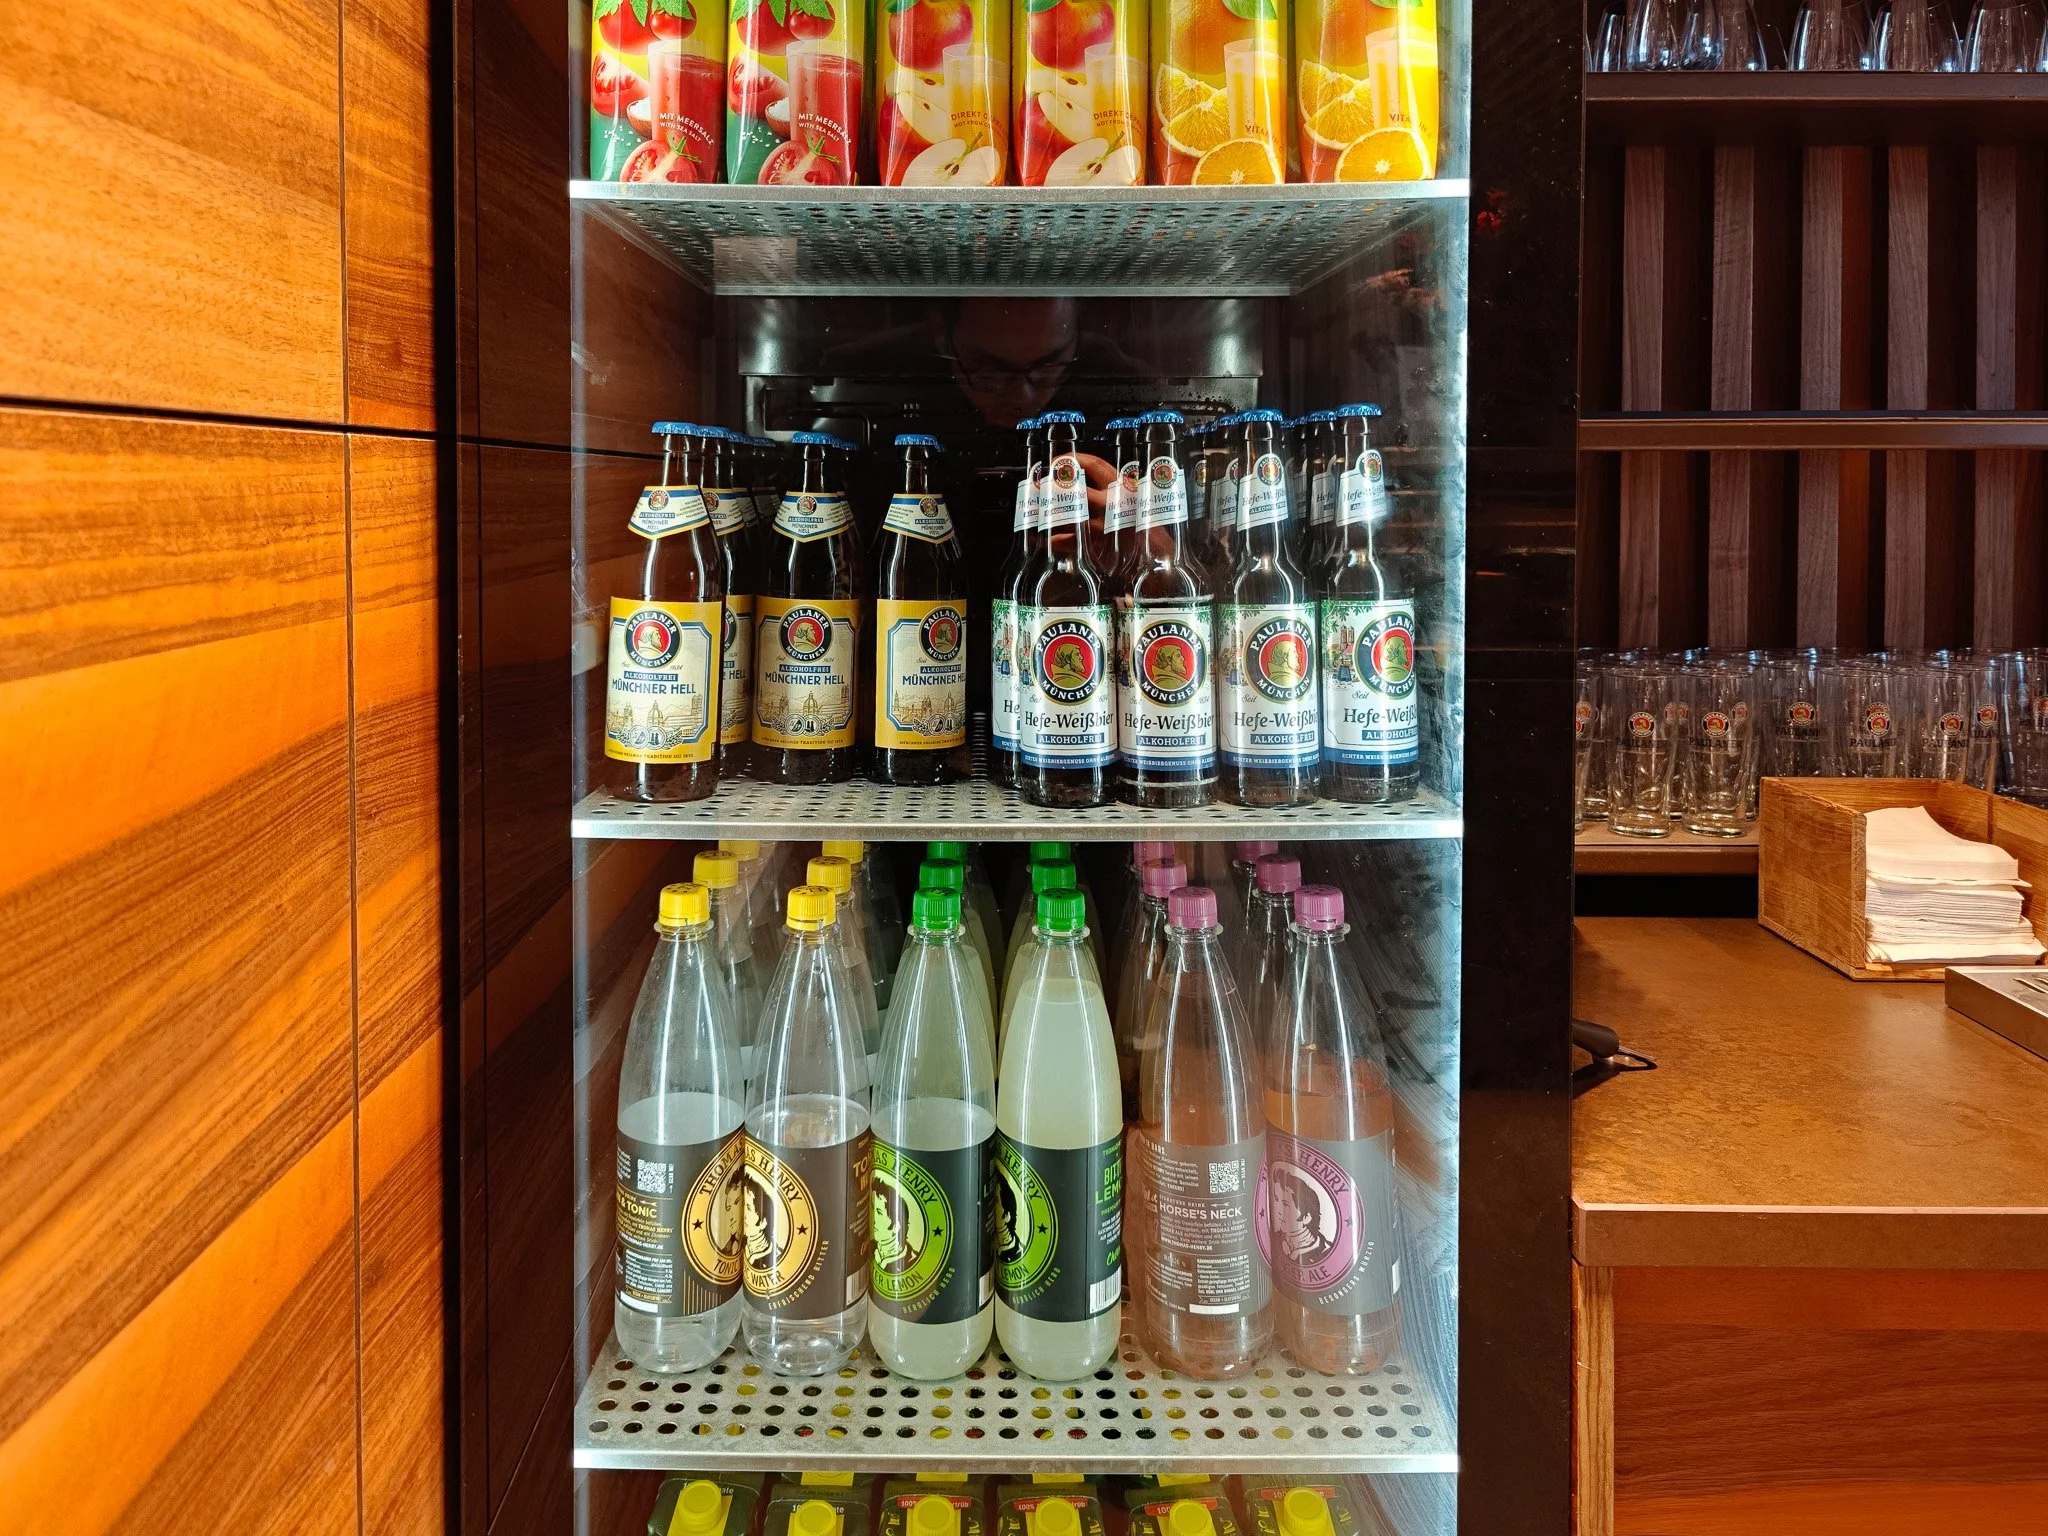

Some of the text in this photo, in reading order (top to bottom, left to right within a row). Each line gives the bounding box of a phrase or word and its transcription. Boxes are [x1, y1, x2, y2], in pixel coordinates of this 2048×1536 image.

[951, 110, 981, 121] DIREKT
[1093, 110, 1124, 121] DIREKT
[659, 112, 714, 146] MIT MEERSALZ
[676, 124, 689, 135] SEA
[688, 130, 702, 142] SALT
[798, 112, 852, 145] MIT MEERSALZ
[815, 124, 828, 134] SEA
[827, 130, 841, 142] SALT
[627, 611, 678, 634] PAULANER
[782, 609, 831, 630] PAULANER
[923, 609, 961, 630] PAULANER
[1035, 623, 1102, 653] PAULANER
[1135, 624, 1203, 654] PAULANER
[1249, 620, 1312, 652] PAULANER
[629, 650, 673, 667] MÜNCHEN
[785, 647, 826, 660] MÜNCHEN
[926, 646, 959, 660] MÜNCHEN
[624, 671, 677, 681] ALKOHOLFREI
[765, 671, 845, 685] MÜNCHNER HELL
[779, 664, 830, 673] ALKOHOLFREI
[611, 678, 697, 694] MÜNCHNER HELL
[902, 673, 957, 686] MÜNCHNER
[1040, 679, 1099, 700] MÜNCHEN
[1256, 677, 1311, 699] MÜNCHEN
[1140, 680, 1200, 702] MÜNCHEN
[1351, 690, 1370, 700] Seit
[1025, 710, 1113, 732] Hefe-Weißbier
[1124, 712, 1215, 734] Hefe-Weißbier
[1038, 734, 1103, 744] ALKOHOLFREI
[1139, 736, 1204, 746] ALKOHOLFREI
[1253, 732, 1314, 744] ALKOHOLFREI
[758, 1155, 803, 1203] HENRY
[892, 1156, 939, 1206] HENRY
[1003, 1149, 1043, 1201] HENRY
[1298, 1152, 1350, 1197] HENRY
[626, 1201, 658, 1219] TONIC
[1160, 1200, 1242, 1220] HORSE'S NECK
[813, 1239, 830, 1272] BITTER
[750, 1270, 787, 1288] WATER
[886, 1270, 924, 1293] LEMON
[1308, 1265, 1332, 1284] ALE
[1318, 1275, 1361, 1306] BESONDERS
